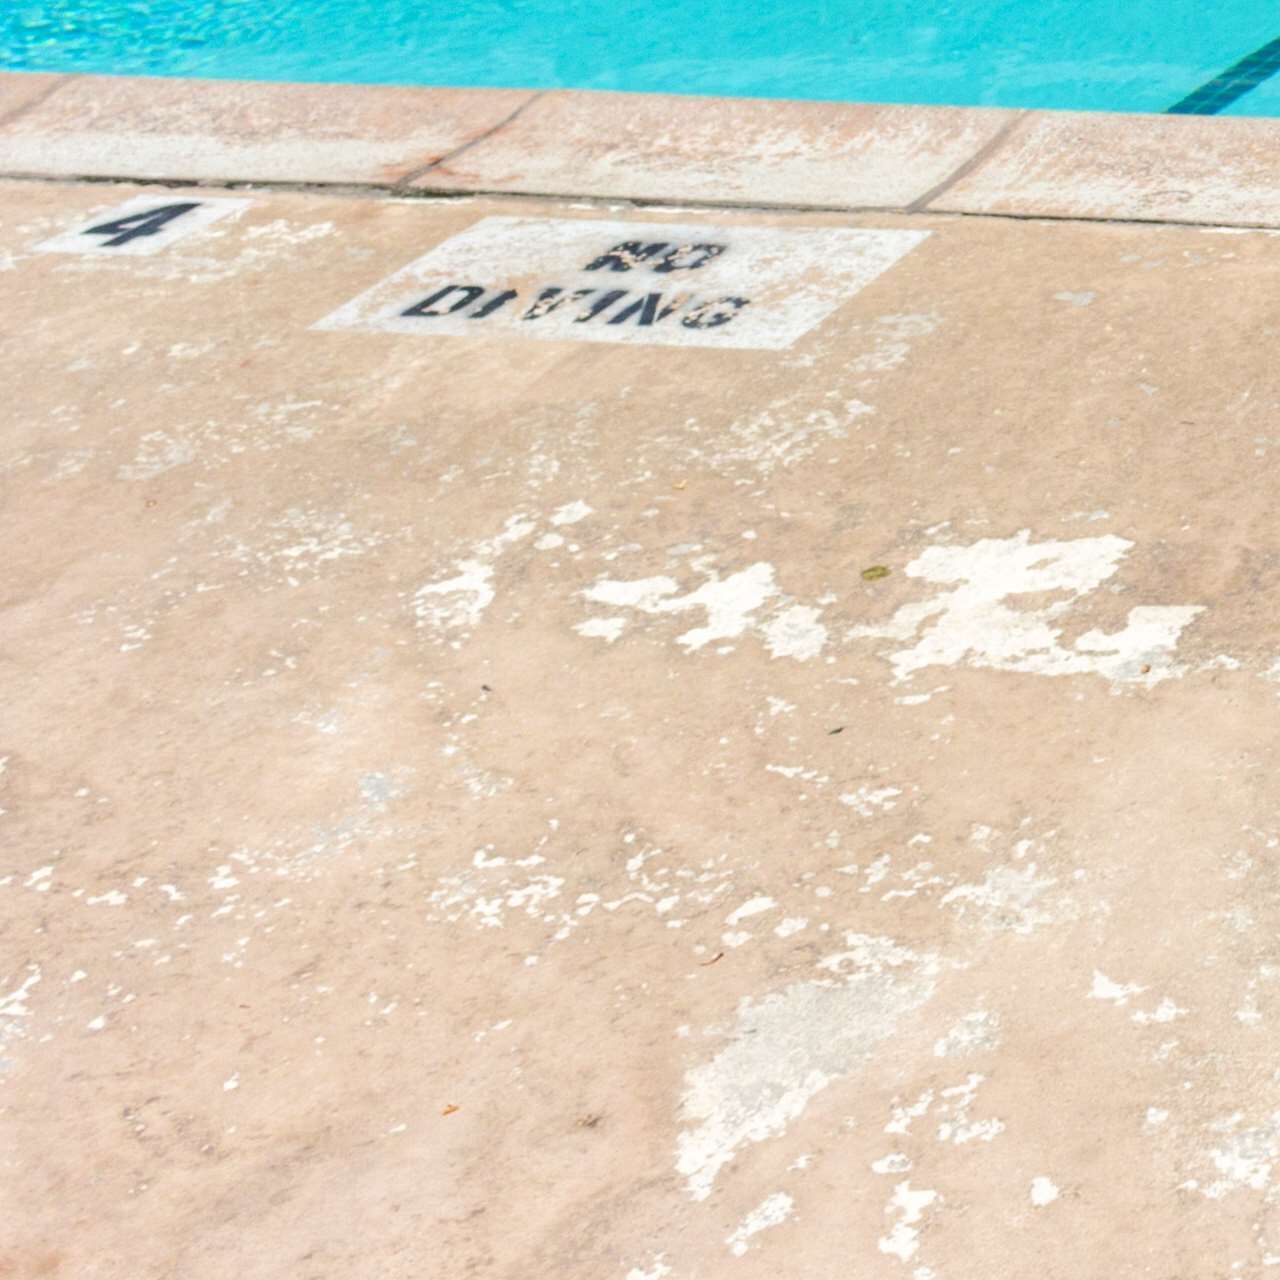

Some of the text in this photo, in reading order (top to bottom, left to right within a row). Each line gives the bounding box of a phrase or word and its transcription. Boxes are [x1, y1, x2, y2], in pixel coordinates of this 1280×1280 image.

[80, 202, 202, 248] 4
[583, 240, 727, 272] NO
[401, 284, 751, 328] DIVING
